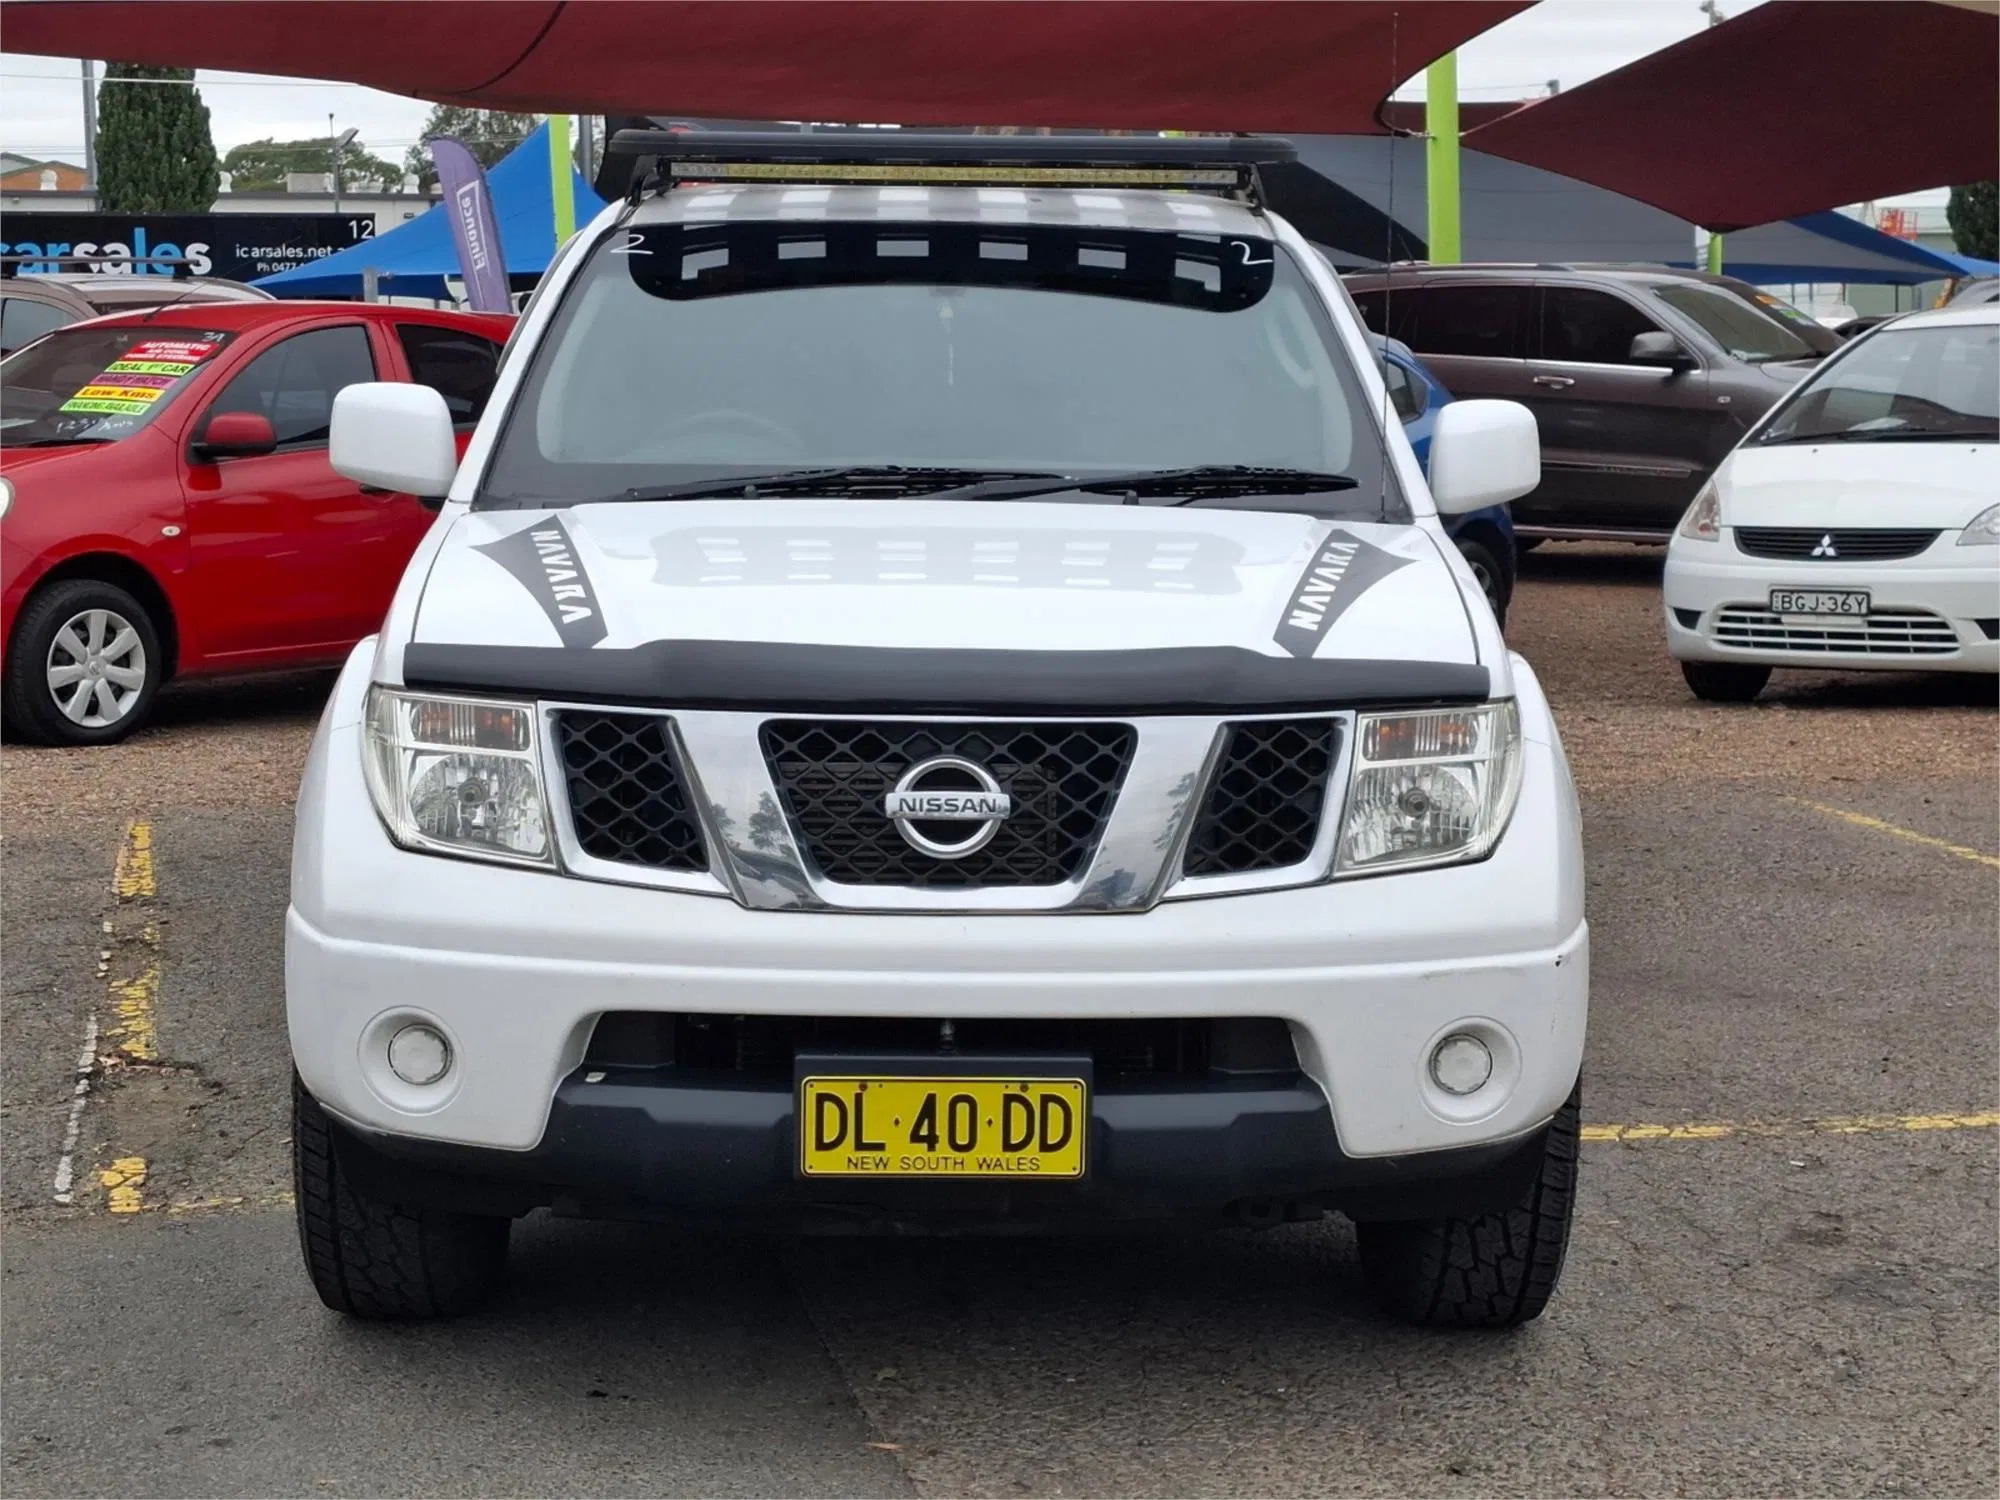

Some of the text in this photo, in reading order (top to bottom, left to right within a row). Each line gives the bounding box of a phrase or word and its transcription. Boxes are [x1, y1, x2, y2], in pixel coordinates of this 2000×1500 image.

[348, 220, 374, 239] 12
[610, 233, 654, 254] 2
[1230, 241, 1273, 265] 2
[257, 262, 270, 272] Ph
[142, 341, 211, 351] AUTOMATIC
[110, 362, 144, 371] IDEAL
[161, 364, 189, 373] CAR
[81, 388, 157, 399] Low Kms
[530, 530, 592, 624] NAVARA
[1288, 542, 1360, 631] NAVARA
[899, 798, 996, 813] NISSAN
[847, 1156, 1040, 1171] NEW SOUTH WALES
